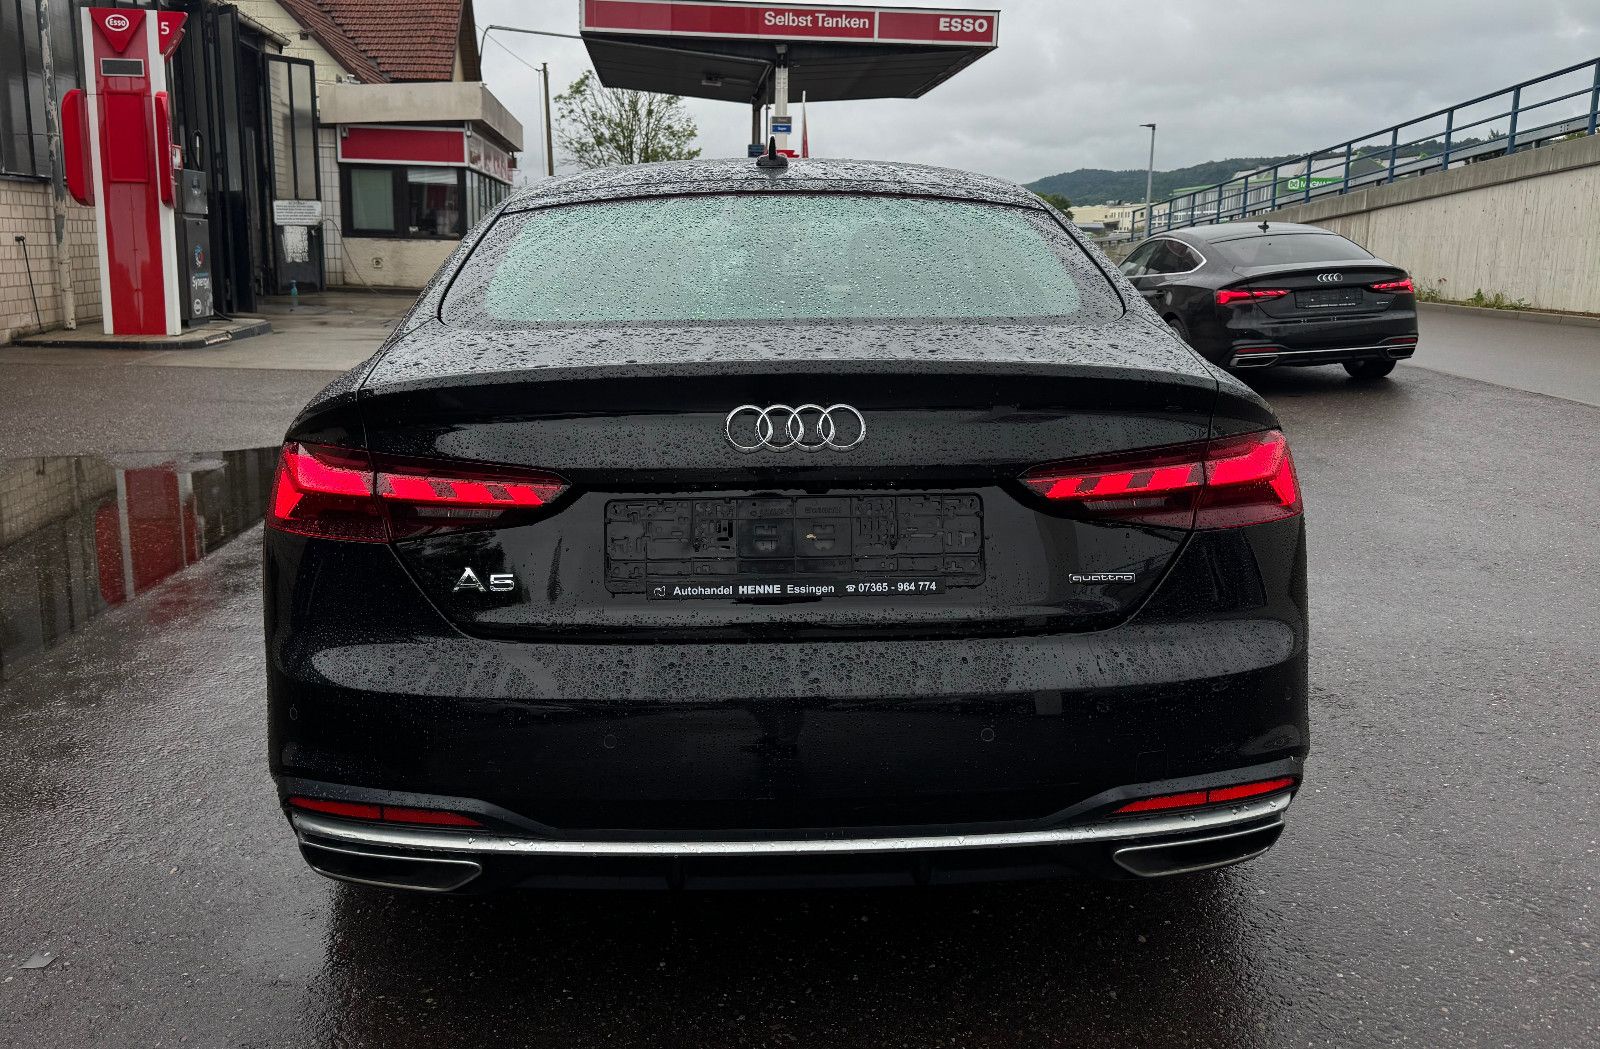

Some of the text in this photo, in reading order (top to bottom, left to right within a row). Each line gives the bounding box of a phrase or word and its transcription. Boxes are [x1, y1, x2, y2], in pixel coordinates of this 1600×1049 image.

[764, 11, 869, 28] Selbst Tanken
[939, 17, 988, 32] ESSO
[160, 22, 170, 35] 5
[452, 567, 515, 592] A5
[1072, 574, 1133, 583] quattro
[673, 584, 733, 596] Autohandel
[738, 584, 782, 595] HENNE
[787, 584, 835, 597] Essingen
[858, 582, 889, 593] 07365
[898, 582, 916, 592] 964
[918, 581, 937, 592] 774
